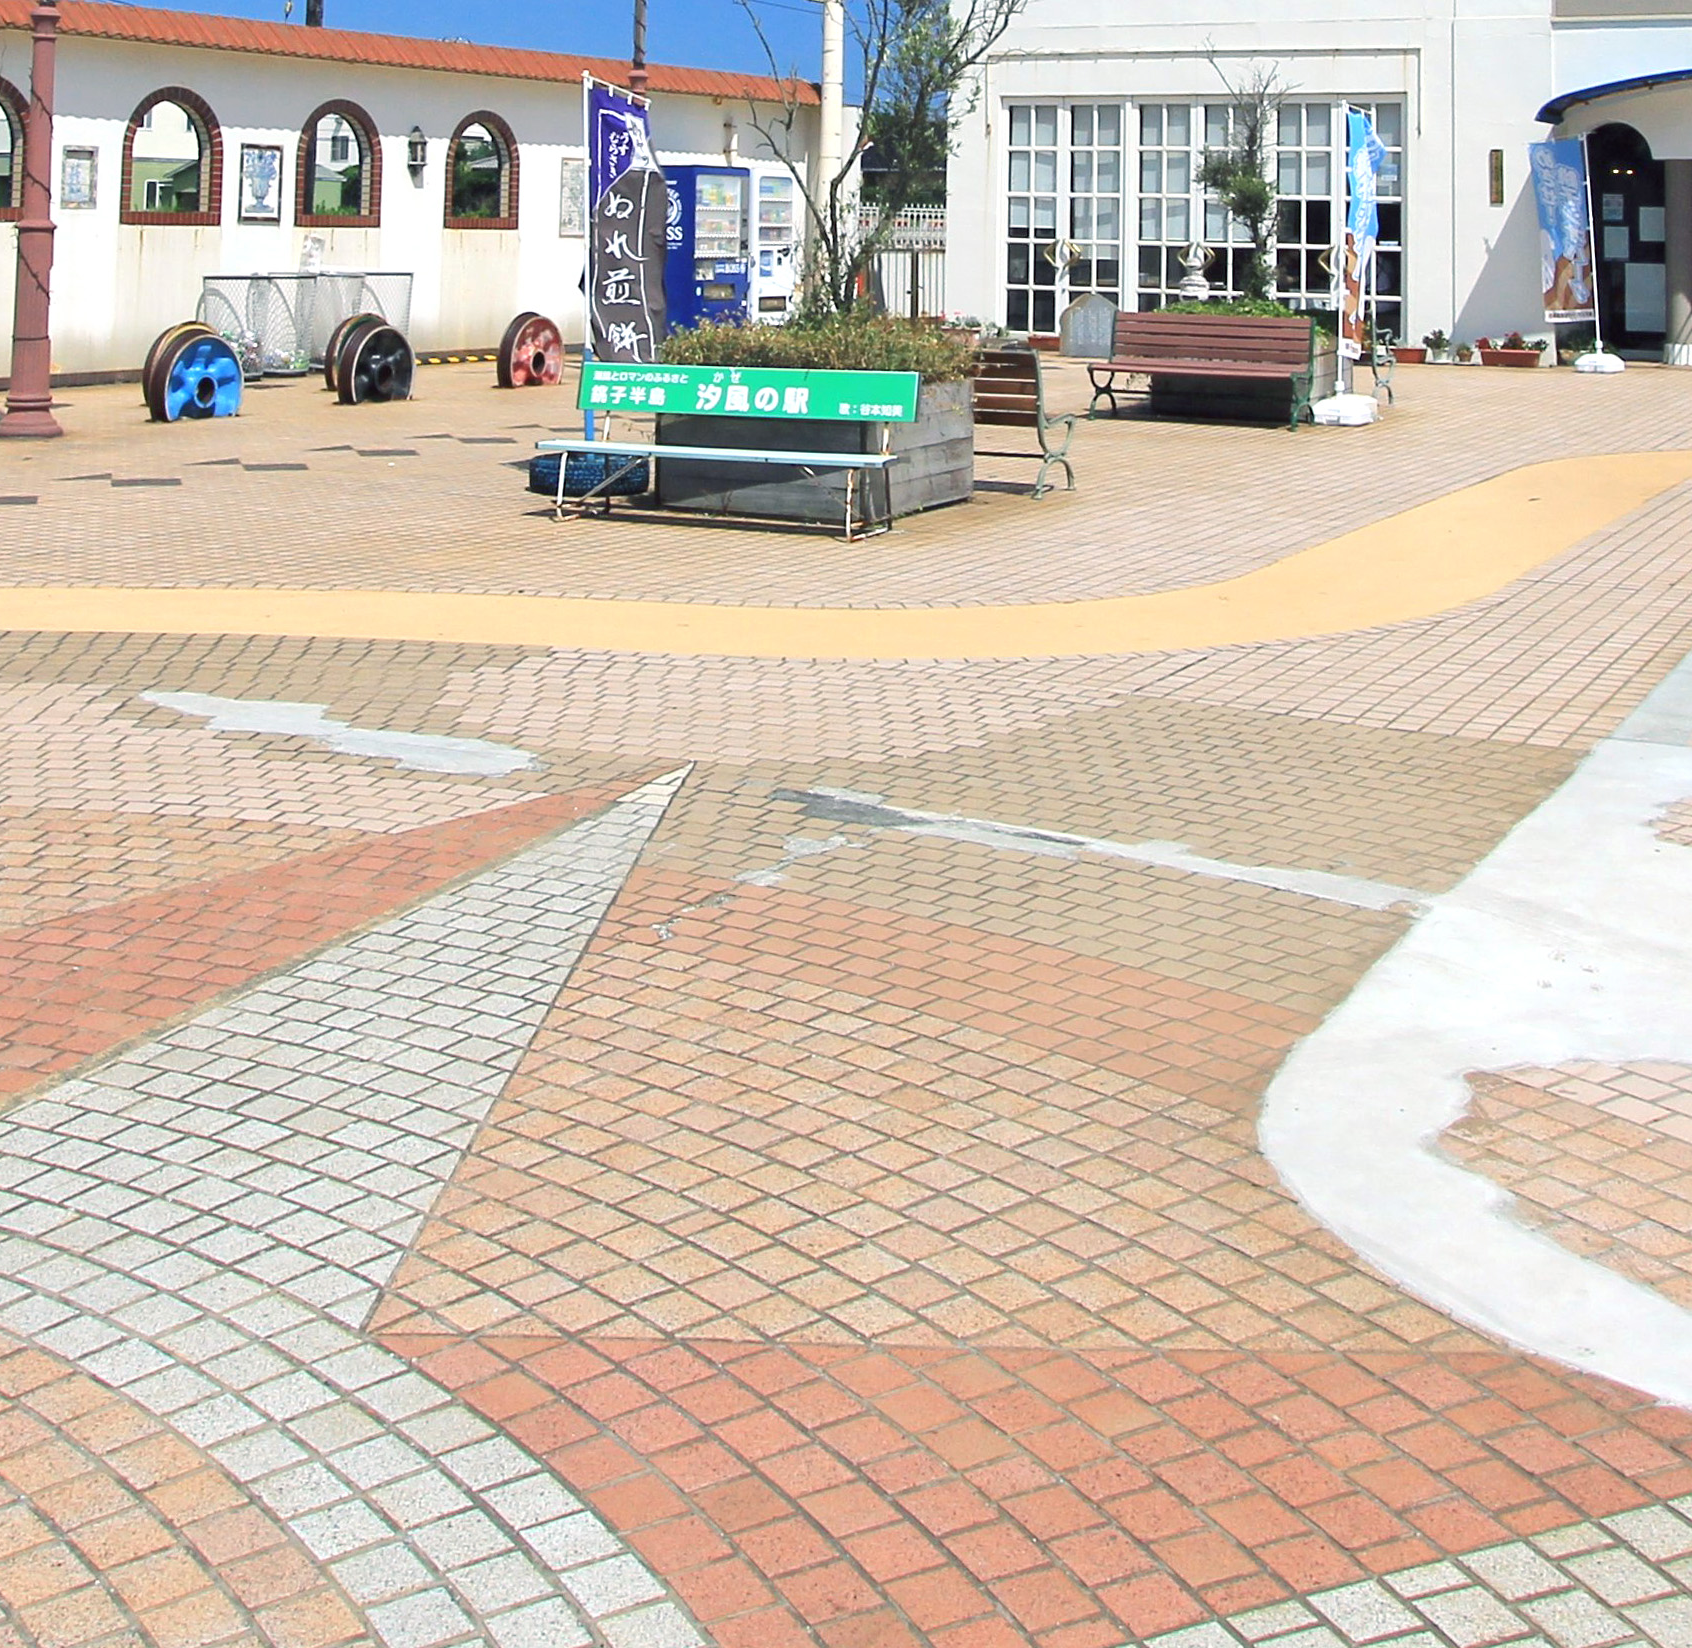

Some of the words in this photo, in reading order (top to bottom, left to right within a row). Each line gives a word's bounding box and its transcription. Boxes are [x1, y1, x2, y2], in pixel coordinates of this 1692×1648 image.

[666, 226, 683, 241] SS
[601, 191, 650, 364] ぬれ煎餅
[590, 384, 667, 406] 銚子半島
[695, 383, 809, 414] 汐風の駅
